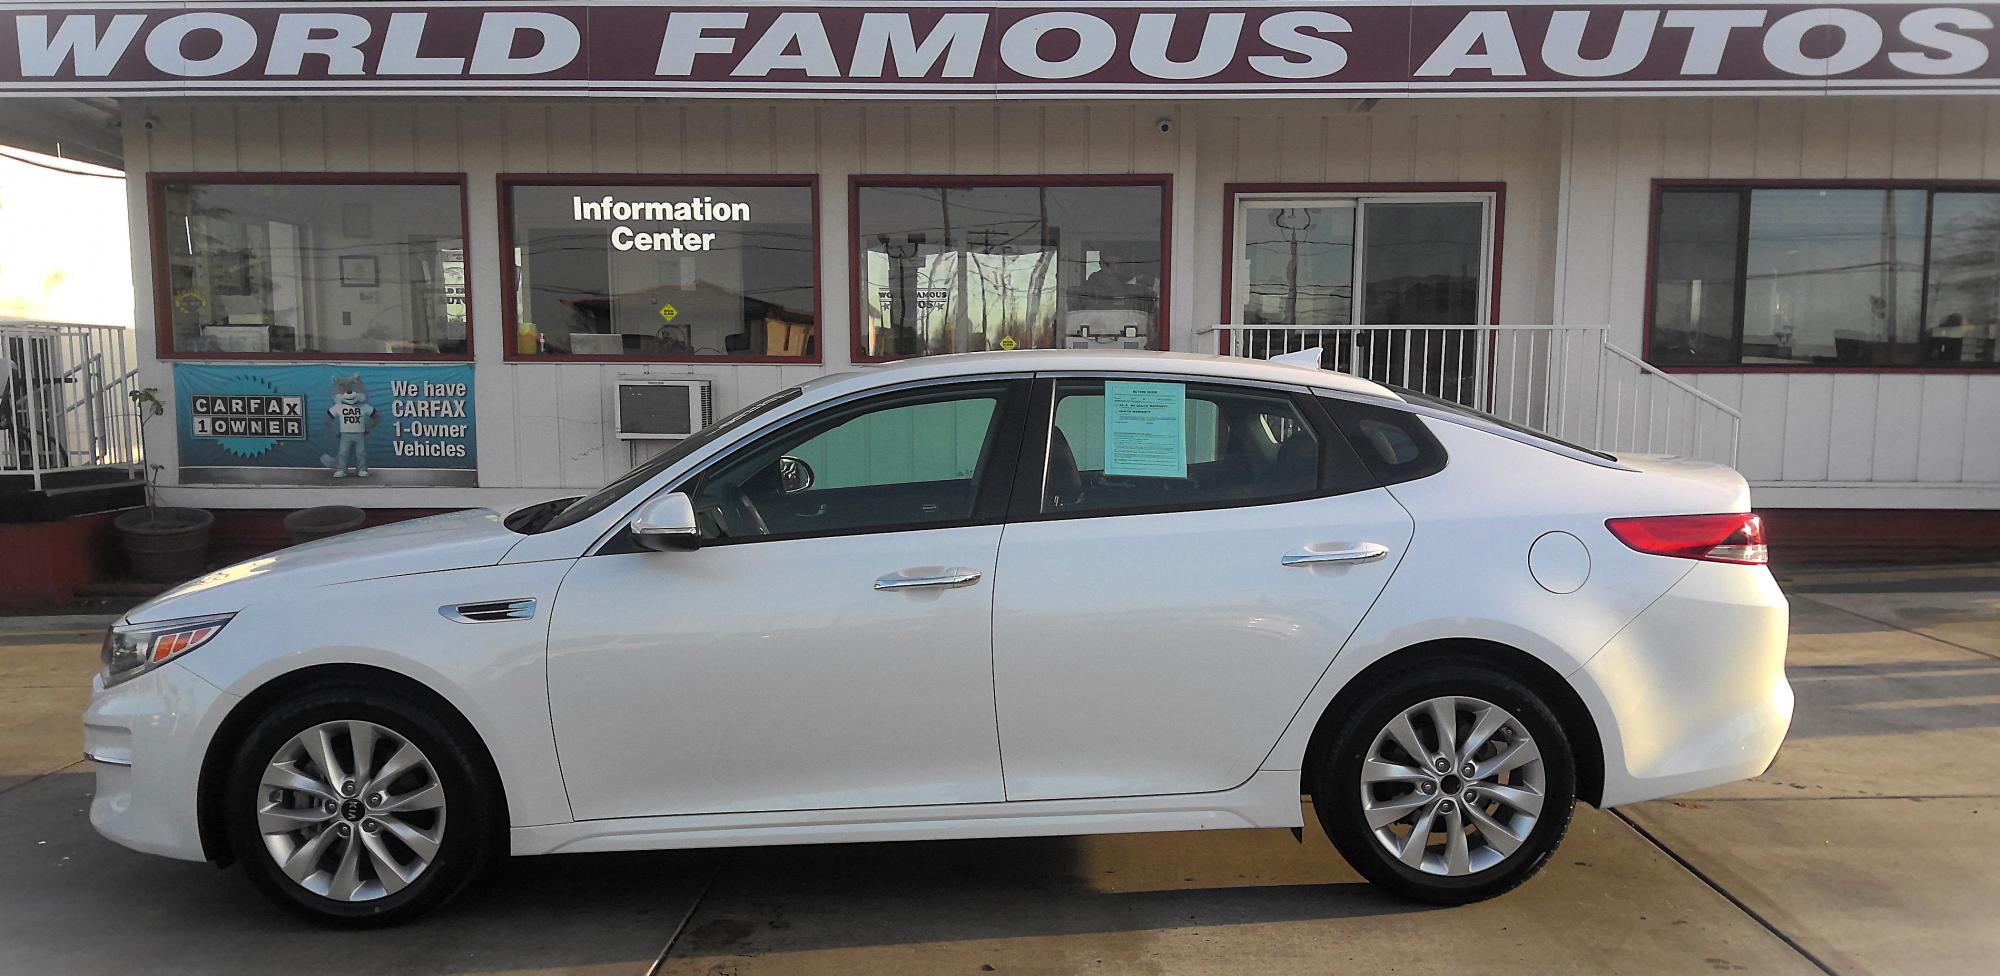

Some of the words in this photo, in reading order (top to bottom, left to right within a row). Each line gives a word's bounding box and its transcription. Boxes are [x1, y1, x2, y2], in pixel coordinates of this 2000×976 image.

[15, 12, 581, 77] WORLD
[654, 10, 1353, 79] FAMOUS
[1413, 7, 1994, 77] AUTOS
[573, 196, 750, 222] Information
[611, 226, 716, 251] Center
[916, 291, 947, 299] AMOUS
[390, 380, 418, 397] We
[424, 381, 466, 397] have
[195, 398, 299, 416] CARFAX
[341, 407, 361, 416] CAR
[391, 400, 466, 418] CARFAX
[343, 416, 361, 425] FOX
[393, 421, 467, 437] 1-Owner
[393, 440, 466, 457] Vehicles
